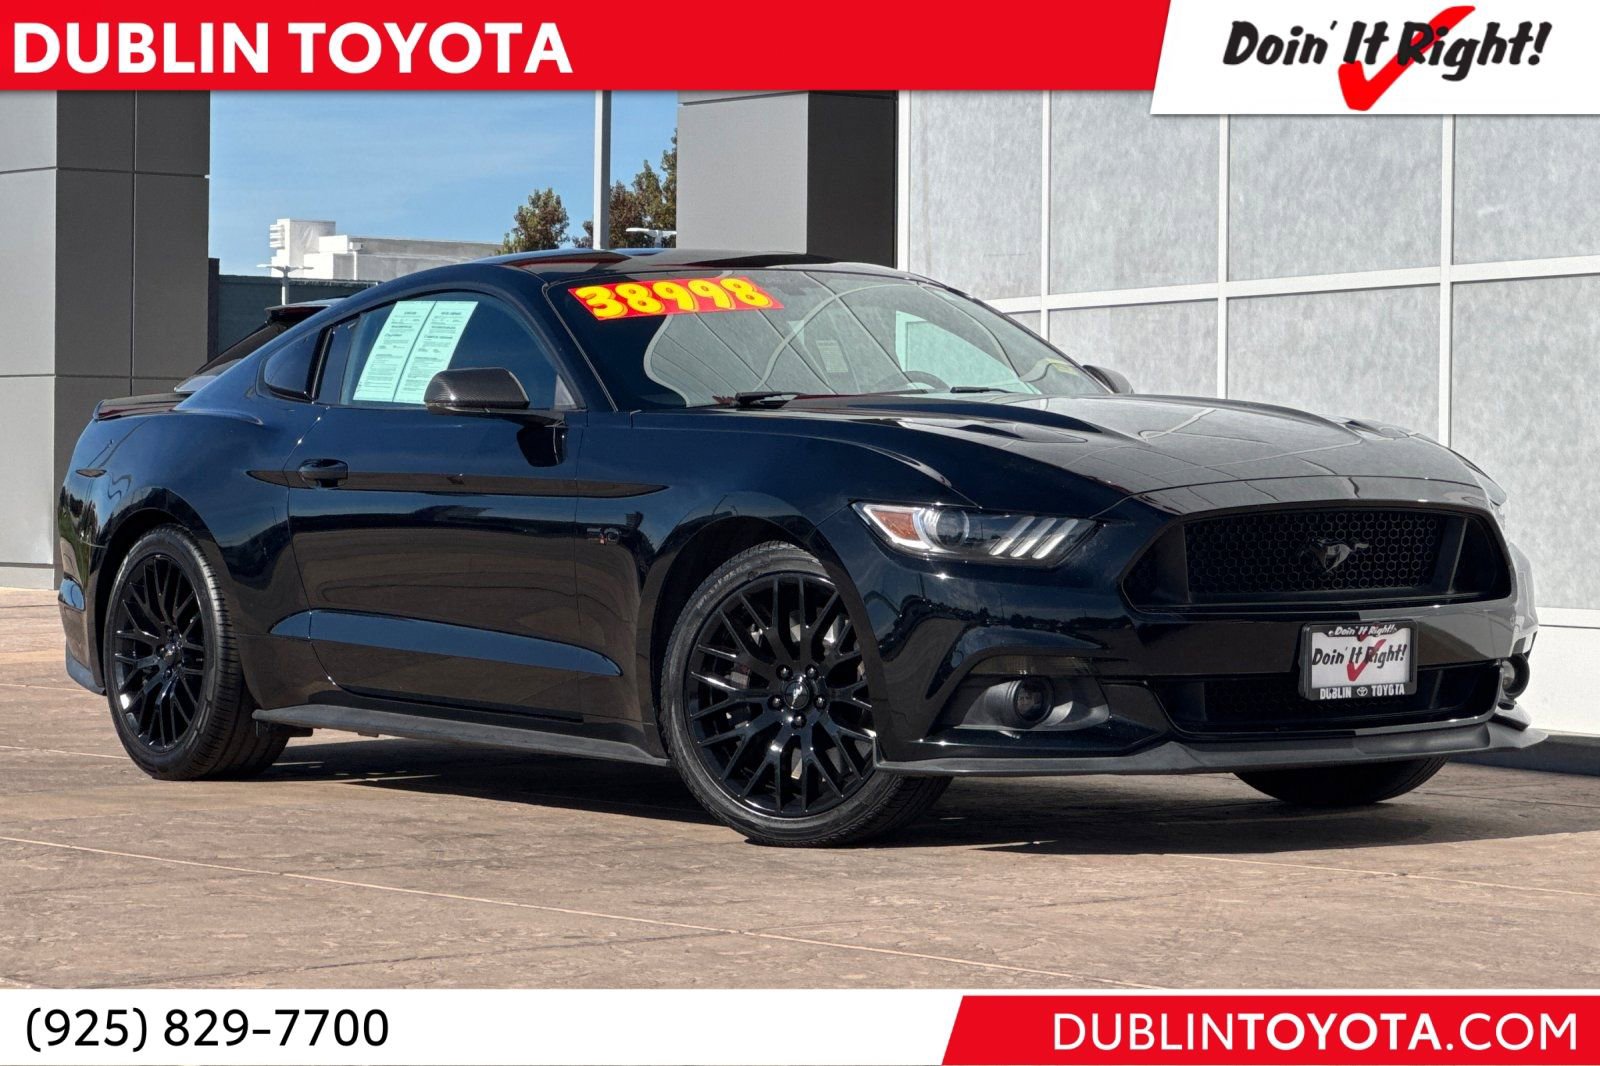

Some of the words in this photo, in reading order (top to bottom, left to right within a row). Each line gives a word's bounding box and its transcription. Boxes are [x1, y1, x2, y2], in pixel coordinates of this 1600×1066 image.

[575, 277, 774, 318] 38998
[1312, 647, 1348, 665] Doin'
[1349, 647, 1362, 664] It
[1365, 644, 1408, 669] Right!
[1320, 687, 1352, 700] DUBLIN
[1371, 683, 1405, 696] TOYOTA
